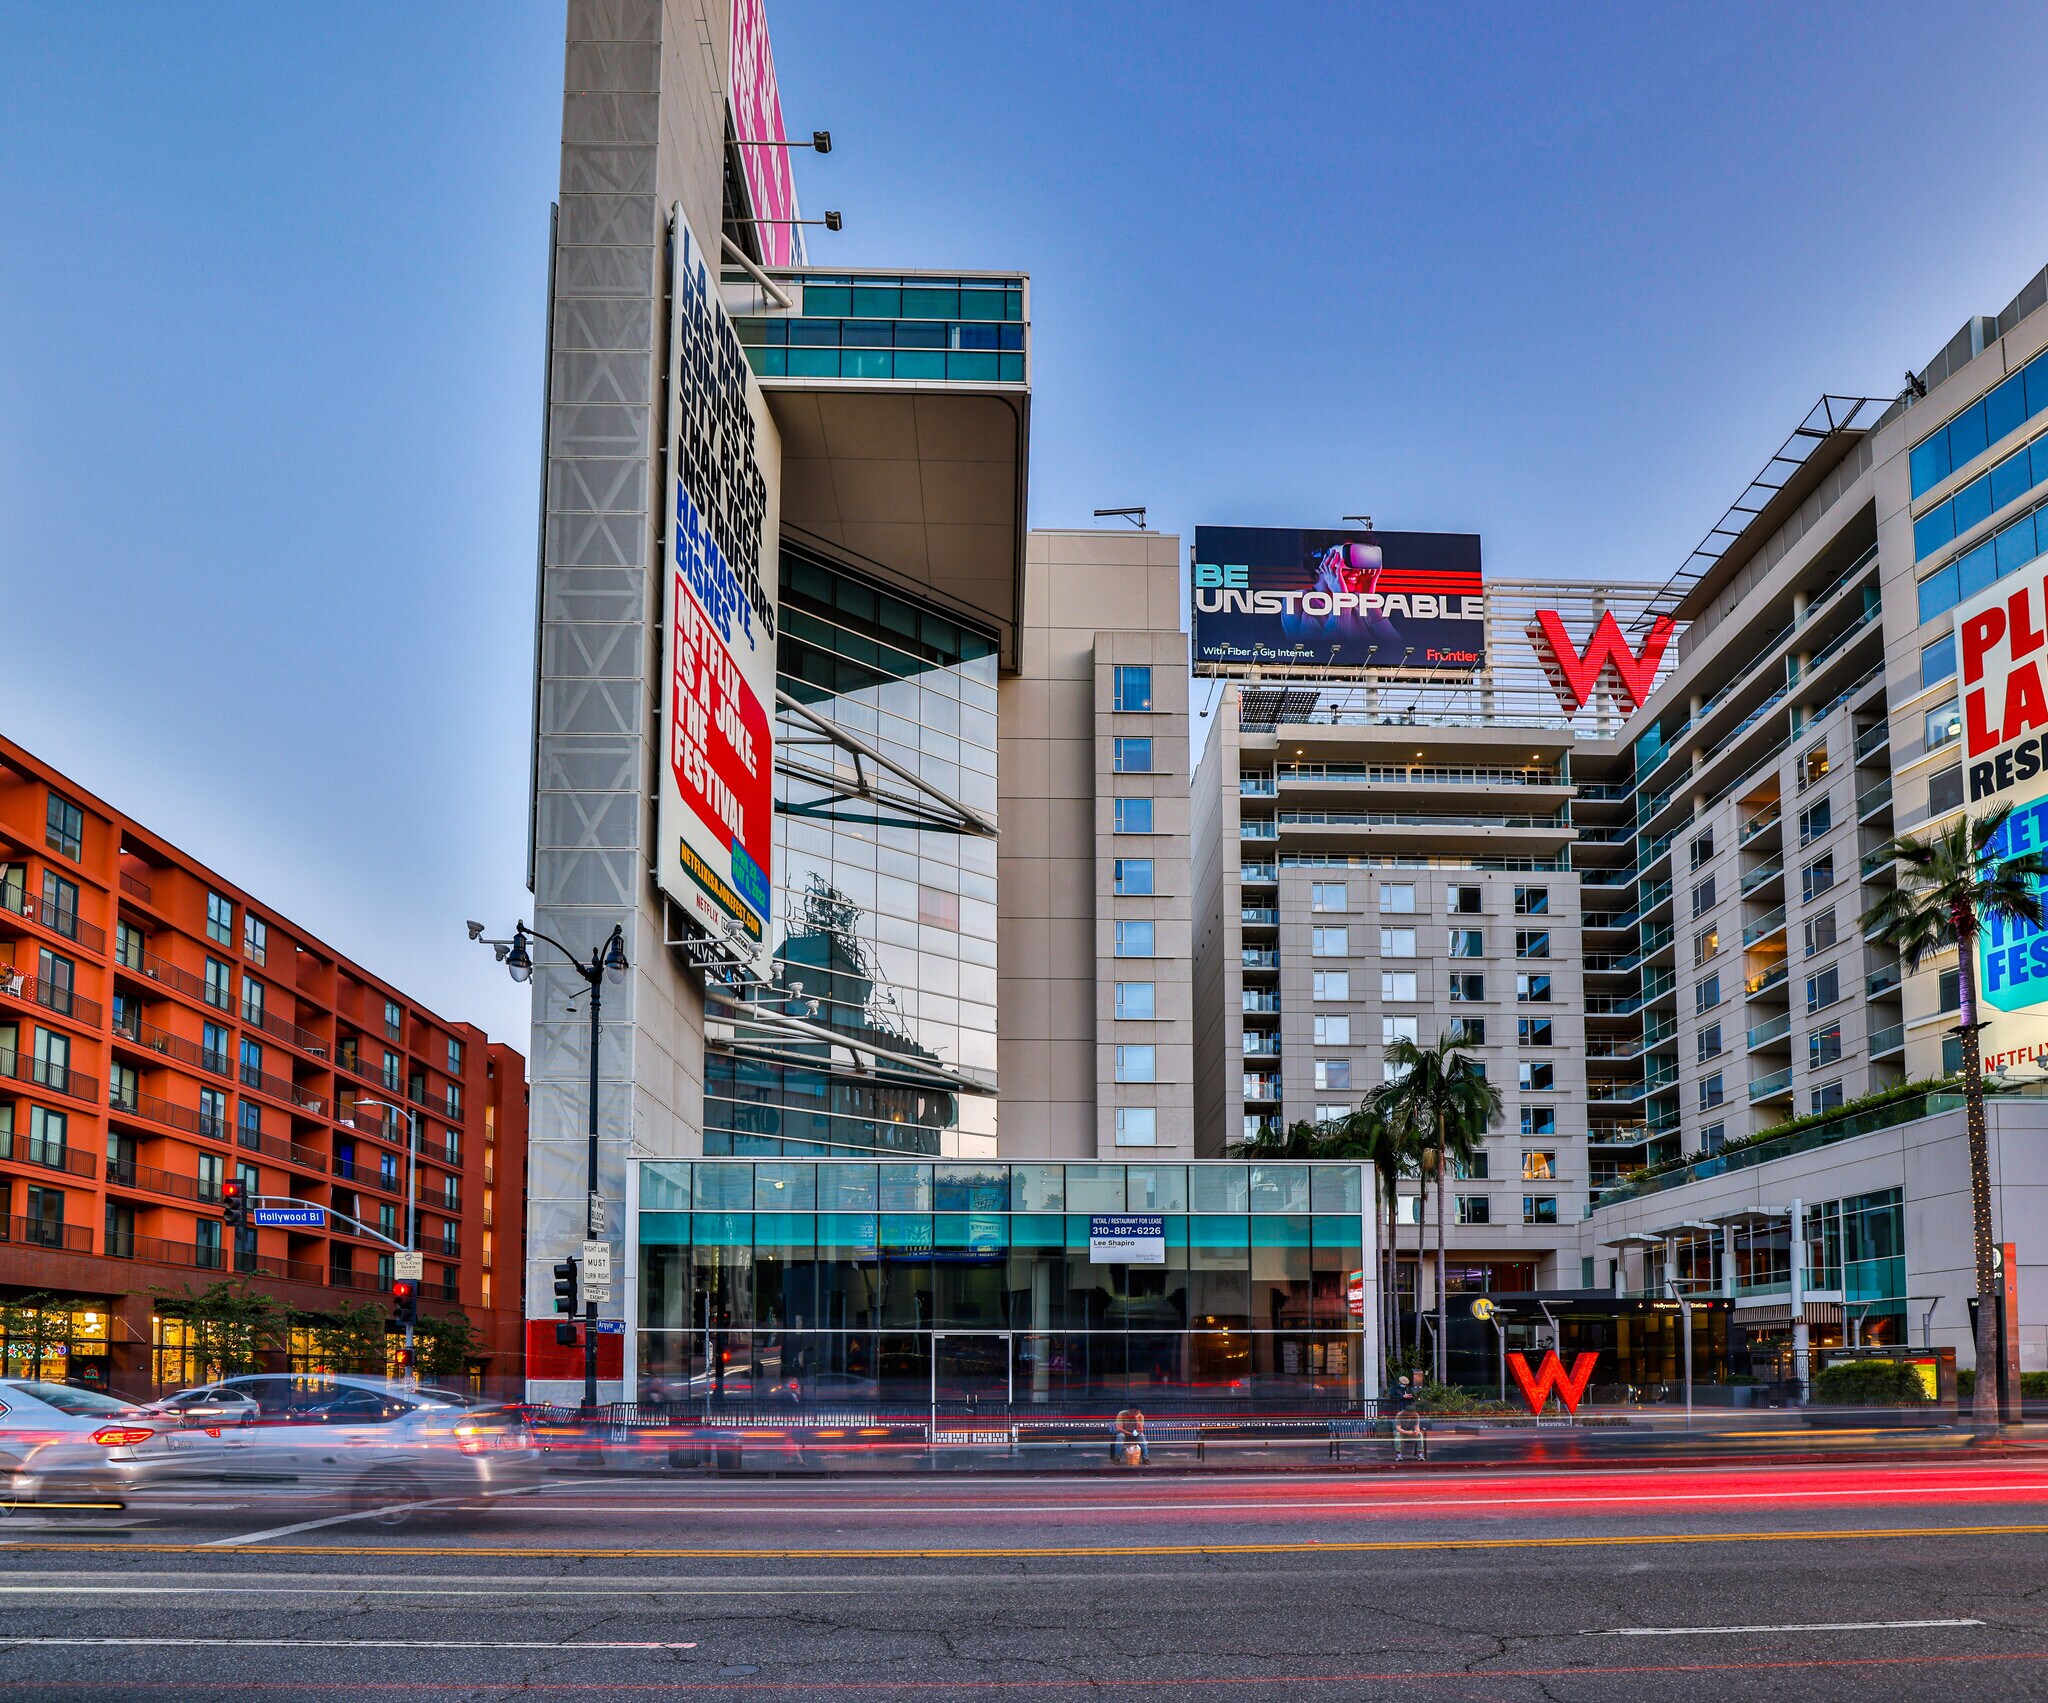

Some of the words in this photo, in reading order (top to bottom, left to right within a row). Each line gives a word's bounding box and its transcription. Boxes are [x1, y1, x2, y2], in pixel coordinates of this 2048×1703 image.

[682, 266, 714, 365] HAS
[718, 350, 756, 456] MORE
[715, 298, 747, 396] NOW
[680, 354, 717, 452] CITY
[720, 438, 763, 548] BLOCK
[681, 312, 741, 461] COMICS
[743, 439, 767, 519] PER
[679, 391, 722, 508] THAN
[725, 478, 760, 580] YOGA
[675, 520, 732, 644] BISHES
[676, 478, 755, 652] HA-MASTE,
[678, 434, 775, 642] INSTRUCTORS
[1196, 563, 1249, 588] BE
[677, 581, 742, 717] NETFLIX
[1196, 588, 1484, 620] UNSTOPPABLE
[1203, 646, 1226, 656] With
[1227, 647, 1252, 657] Fiber
[1260, 649, 1276, 659] Gig
[1277, 649, 1315, 658] Internet
[1426, 648, 1479, 662] Frontier
[1535, 609, 1677, 710] W
[675, 674, 709, 756] THE
[676, 627, 696, 690] IS
[699, 664, 711, 716] A
[714, 691, 757, 780] JOKE:
[674, 721, 746, 847] FESTIVAL
[681, 842, 760, 937] NETFLIXISAJOKEFEST.COM
[696, 893, 719, 925] NETFLIX
[733, 858, 745, 885] MAY
[259, 1212, 307, 1223] Hollywood
[309, 1212, 320, 1221] Bl
[587, 1259, 606, 1267] MUST
[1092, 1226, 1161, 1235] 310-887-6226
[599, 1322, 614, 1331] Argyle
[1504, 1350, 1599, 1416] W
